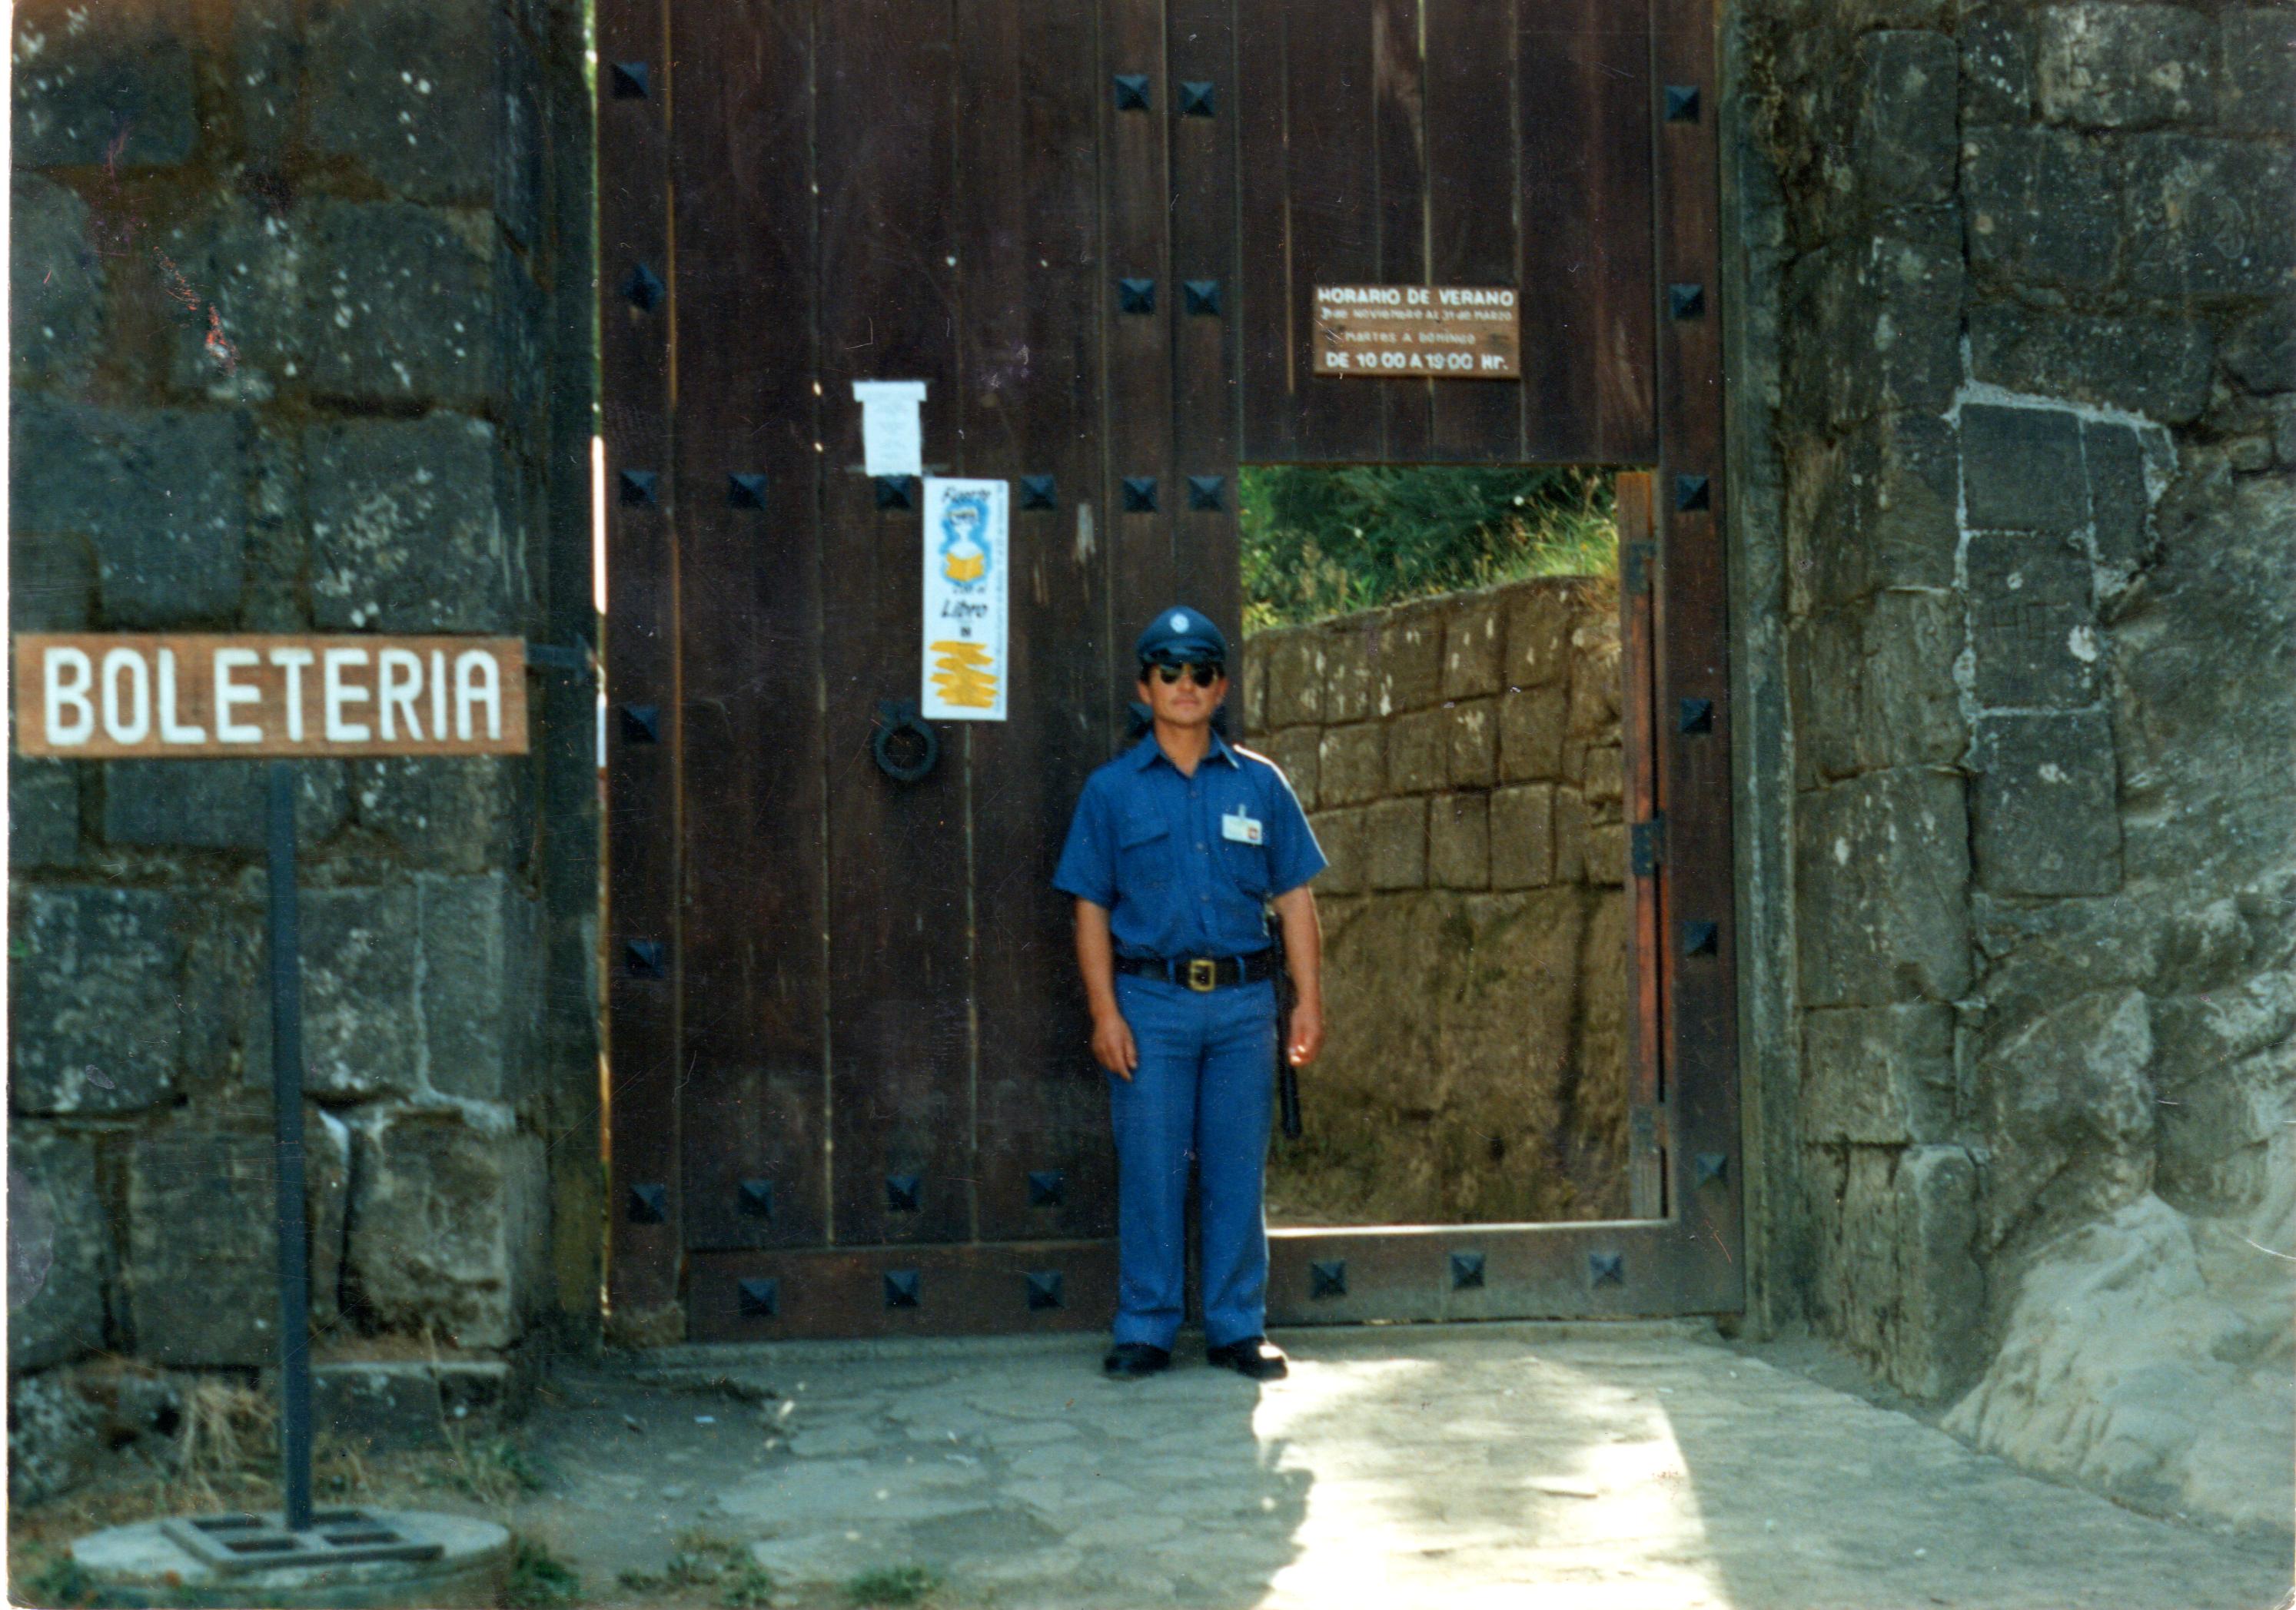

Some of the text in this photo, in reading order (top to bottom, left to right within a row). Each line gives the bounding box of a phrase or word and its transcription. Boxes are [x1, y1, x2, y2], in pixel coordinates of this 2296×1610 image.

[1317, 287, 1514, 307] HORARIO DE VERANO
[1402, 332, 1414, 344] A
[1325, 352, 1351, 369] DE
[1410, 354, 1424, 369] A
[44, 646, 502, 745] BOLETERIA
